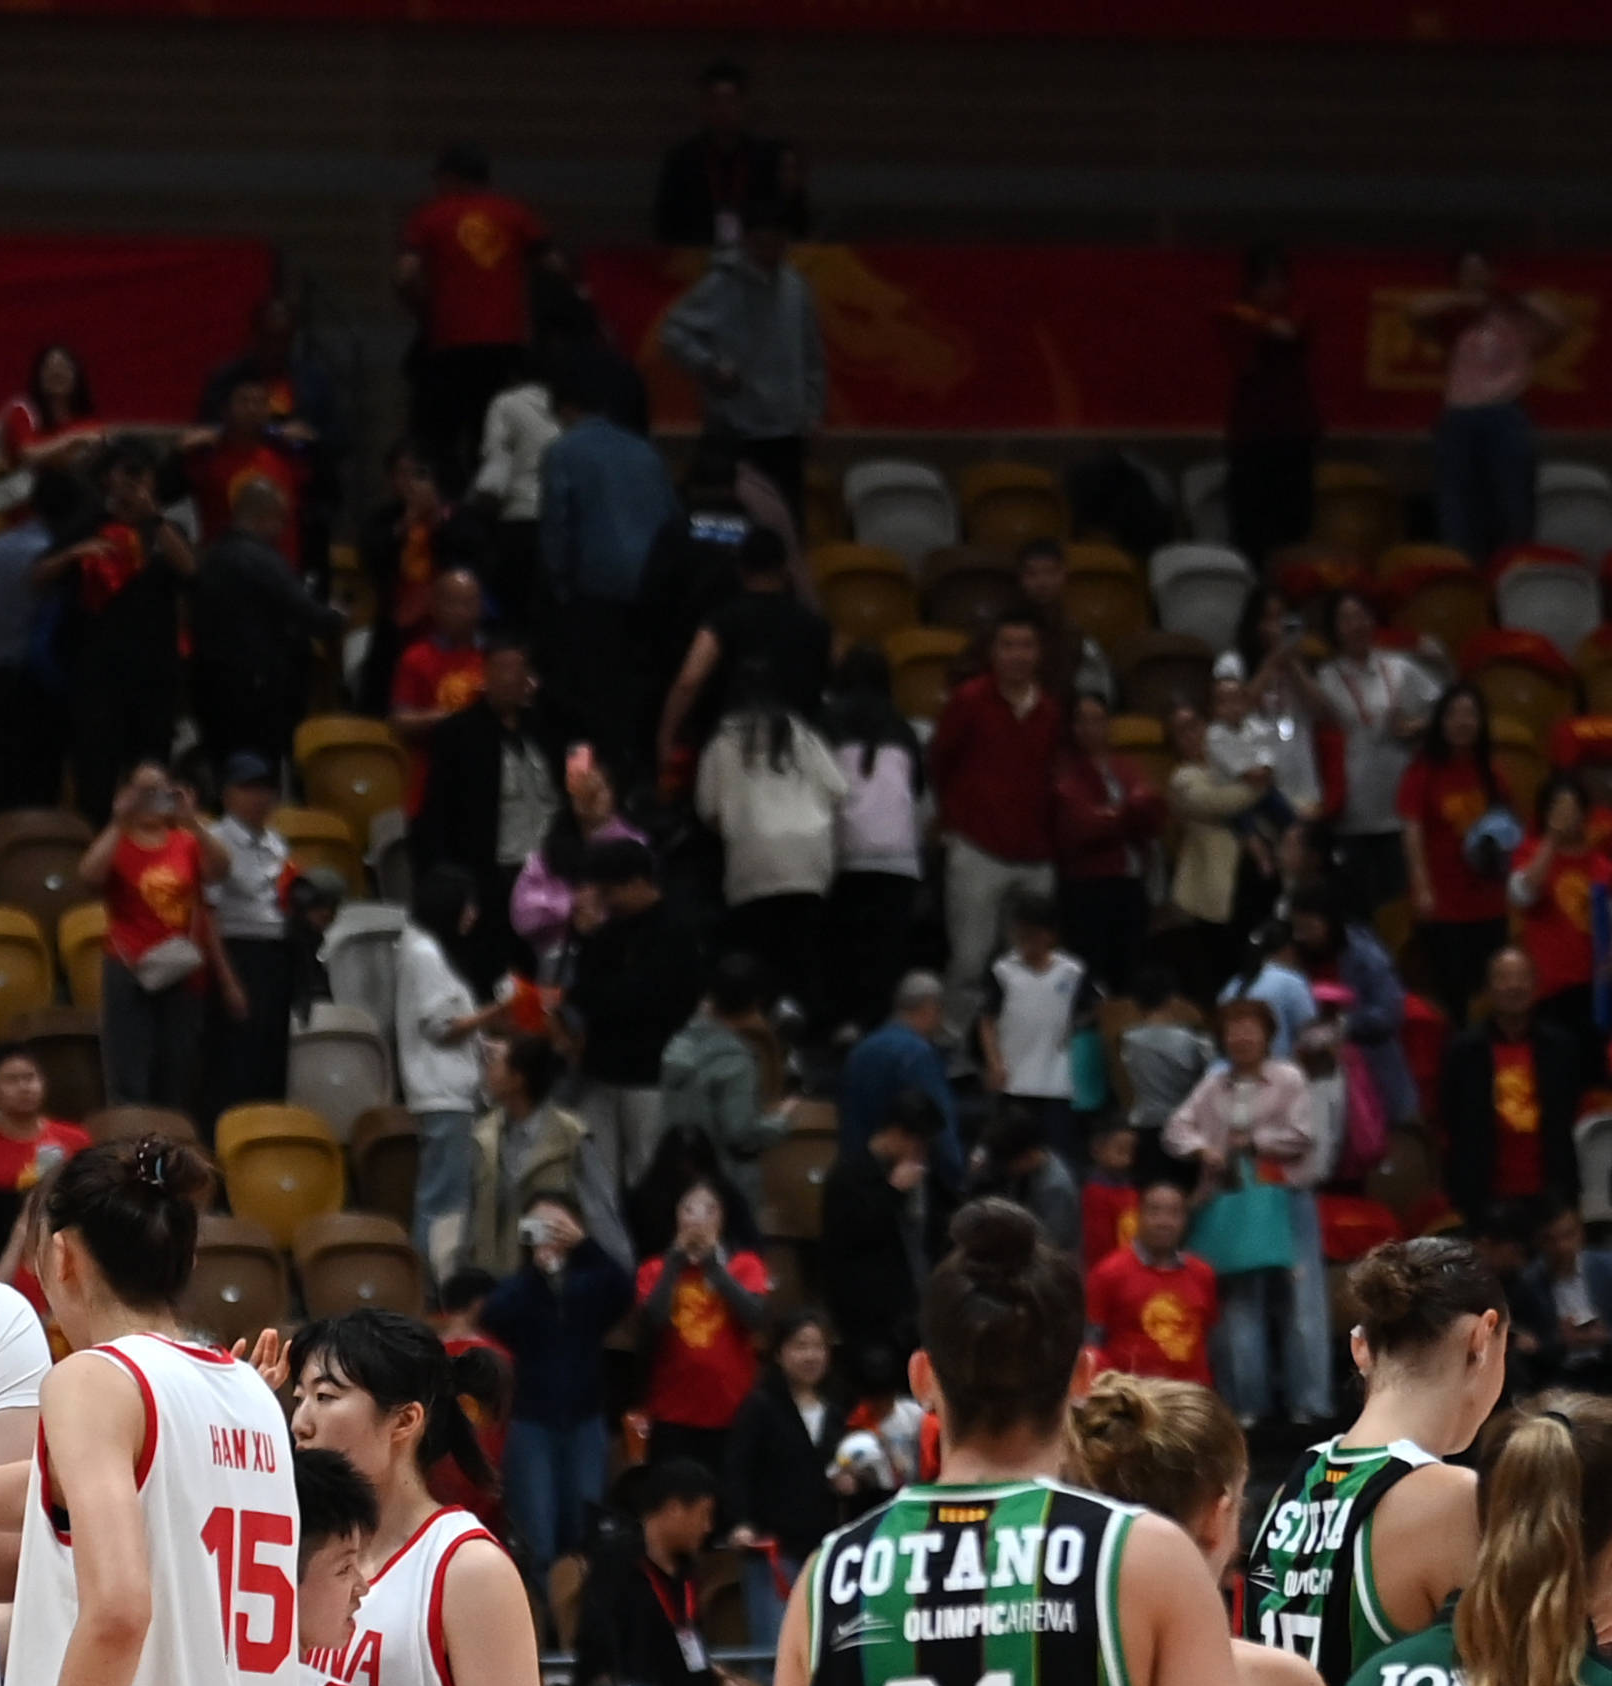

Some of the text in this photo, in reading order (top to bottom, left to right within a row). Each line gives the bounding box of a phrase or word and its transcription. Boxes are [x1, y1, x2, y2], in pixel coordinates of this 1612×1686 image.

[209, 1424, 277, 1474] HAN XU
[200, 1506, 295, 1674] 15
[830, 1526, 1085, 1605] COTANO
[903, 1600, 1078, 1643] OLIMPICARENA
